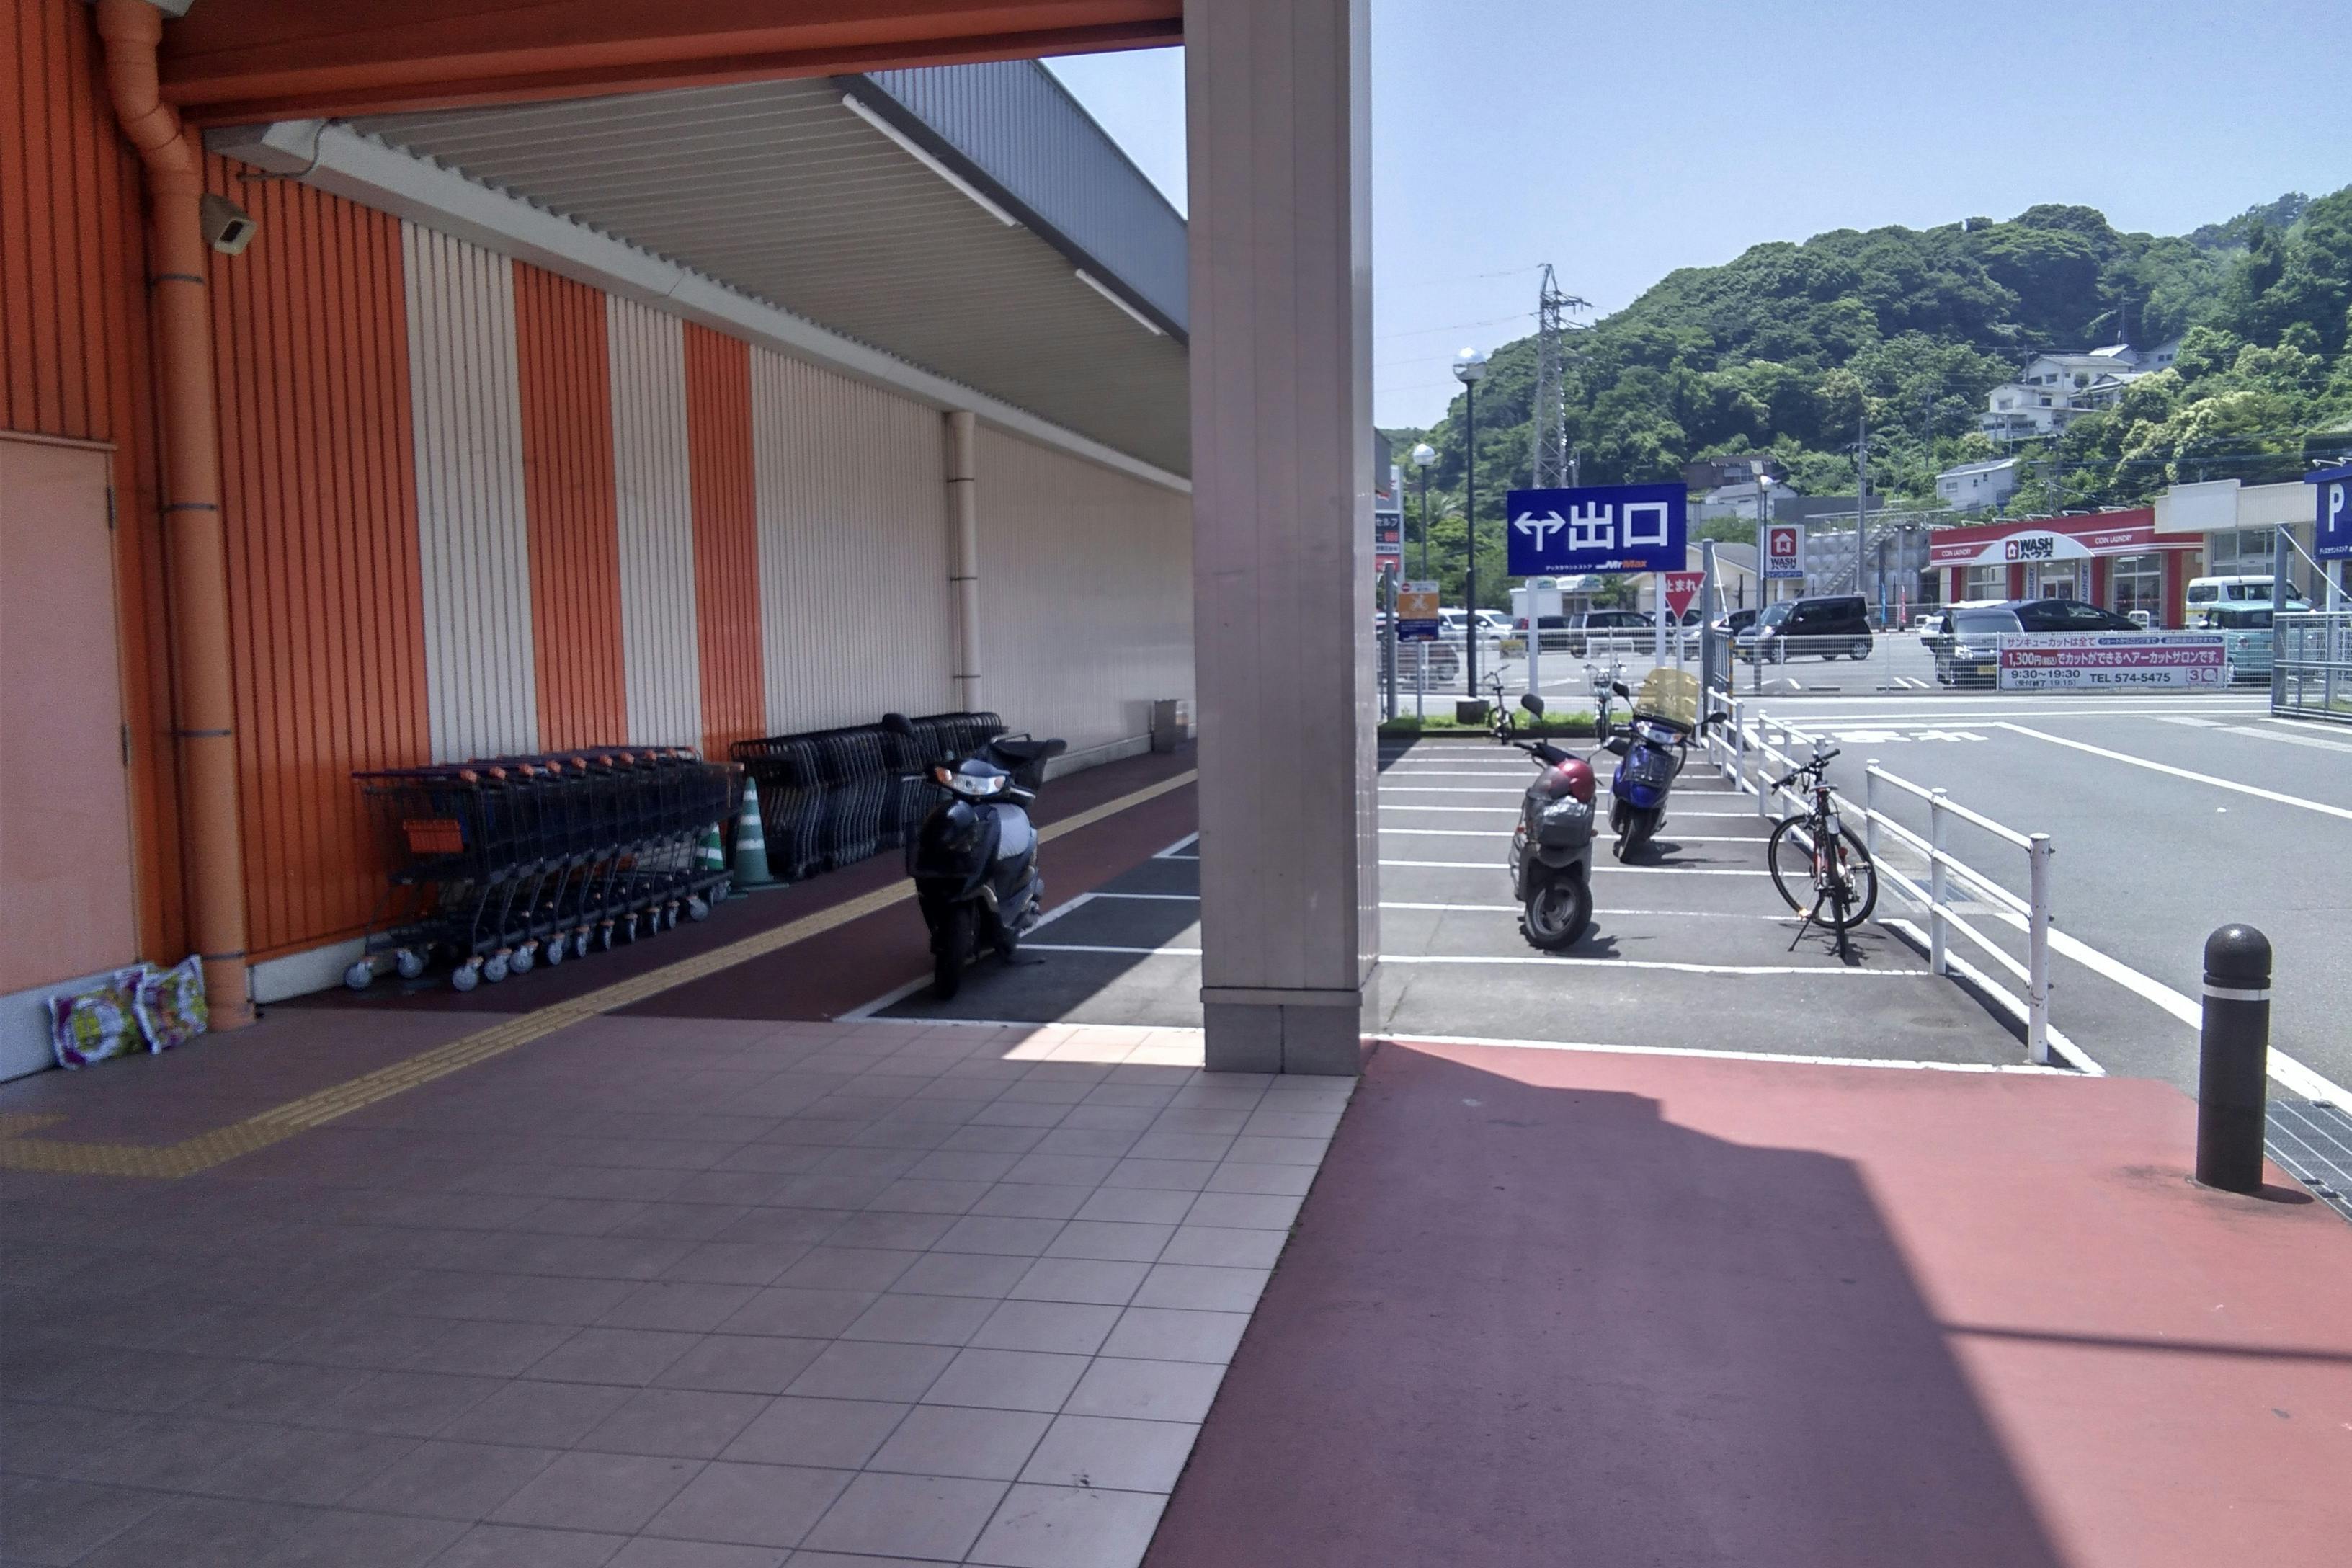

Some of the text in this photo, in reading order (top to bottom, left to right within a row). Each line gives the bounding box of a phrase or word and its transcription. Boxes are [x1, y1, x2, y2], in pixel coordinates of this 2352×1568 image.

[2328, 483, 2345, 532] P
[1569, 501, 1668, 551] 出口
[2020, 537, 2054, 553] WASH
[1595, 560, 1647, 570] MrMax
[1665, 579, 1696, 592] 止まれ
[2008, 637, 2096, 648] サンキューカットは全て
[2090, 672, 2171, 683] TEL 574-5475
